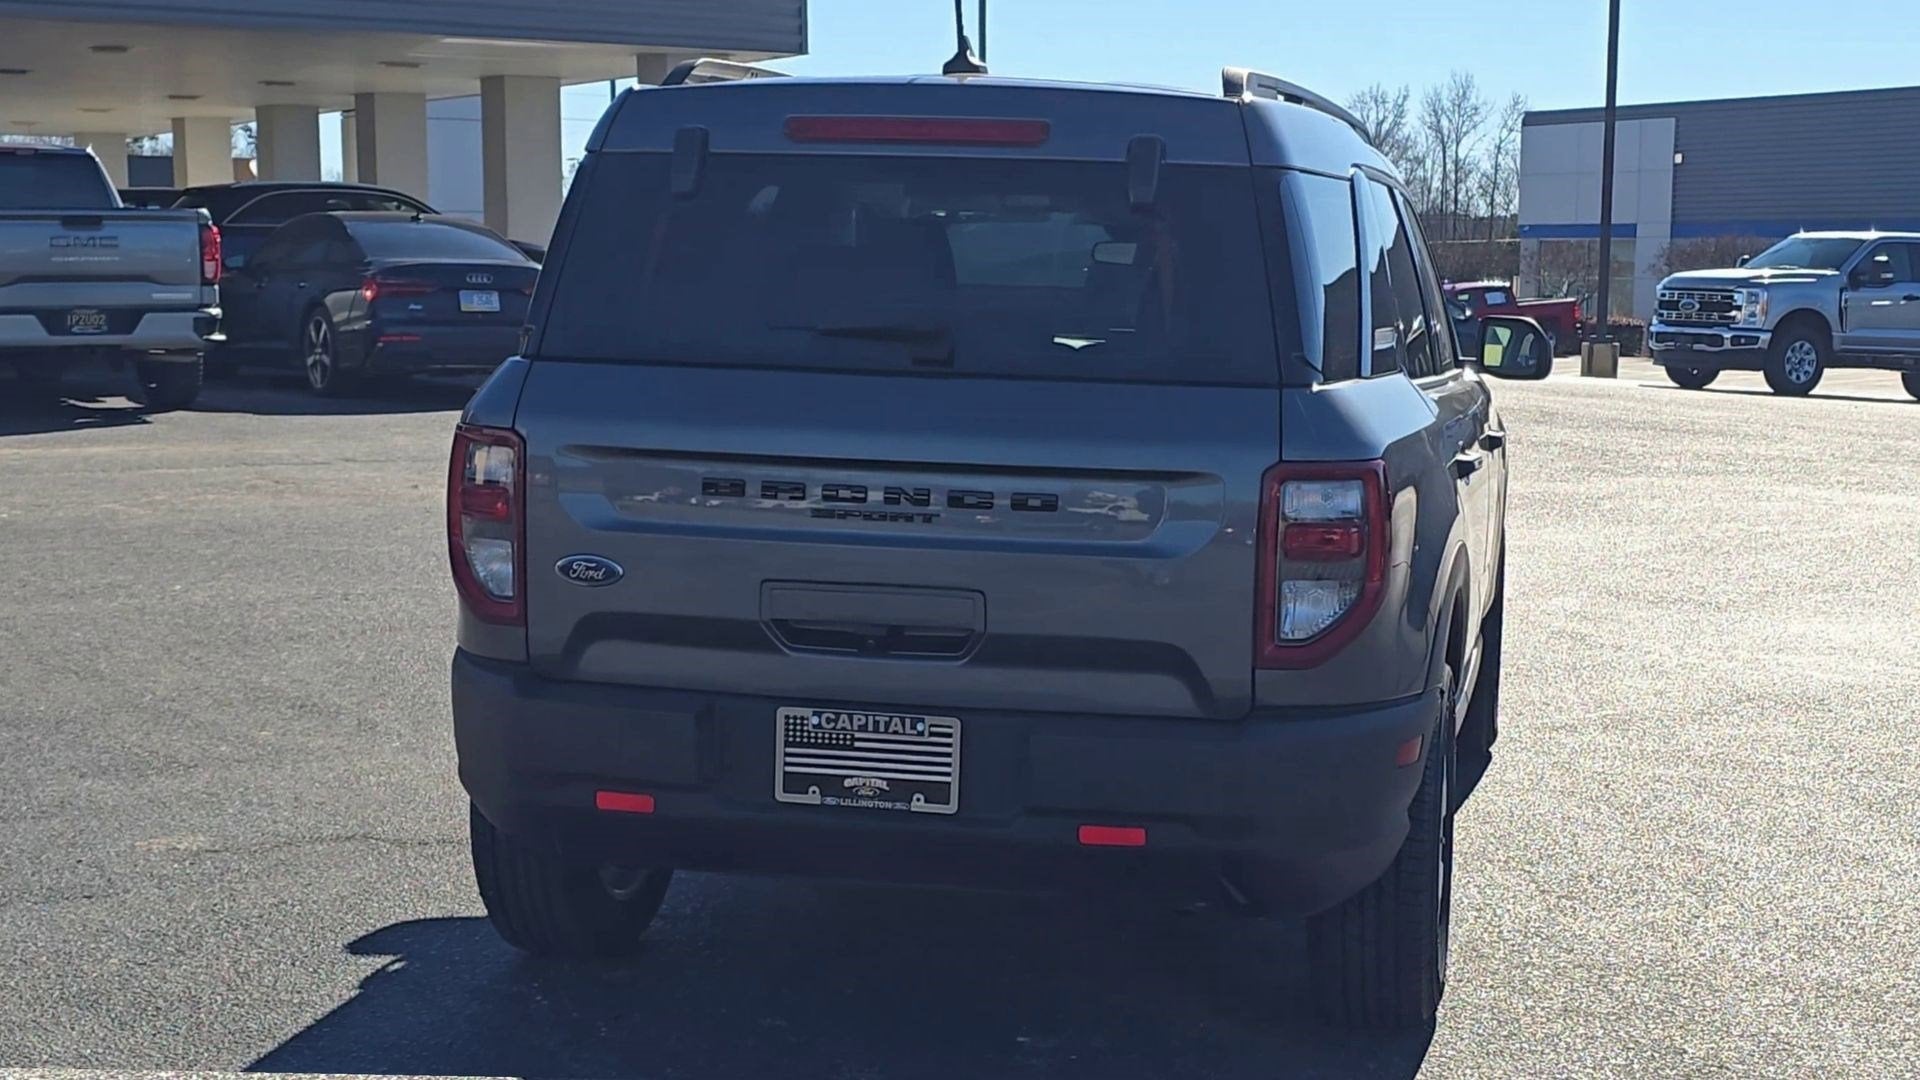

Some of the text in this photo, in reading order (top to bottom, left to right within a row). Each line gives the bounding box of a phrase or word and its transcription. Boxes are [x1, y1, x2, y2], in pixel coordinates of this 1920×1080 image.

[50, 236, 119, 248] GMC
[701, 477, 1059, 512] BRONCO
[810, 508, 940, 524] SPORT
[569, 561, 606, 580] Ford
[820, 713, 917, 734] CAPITAL
[840, 798, 892, 809] LILLINGTON
